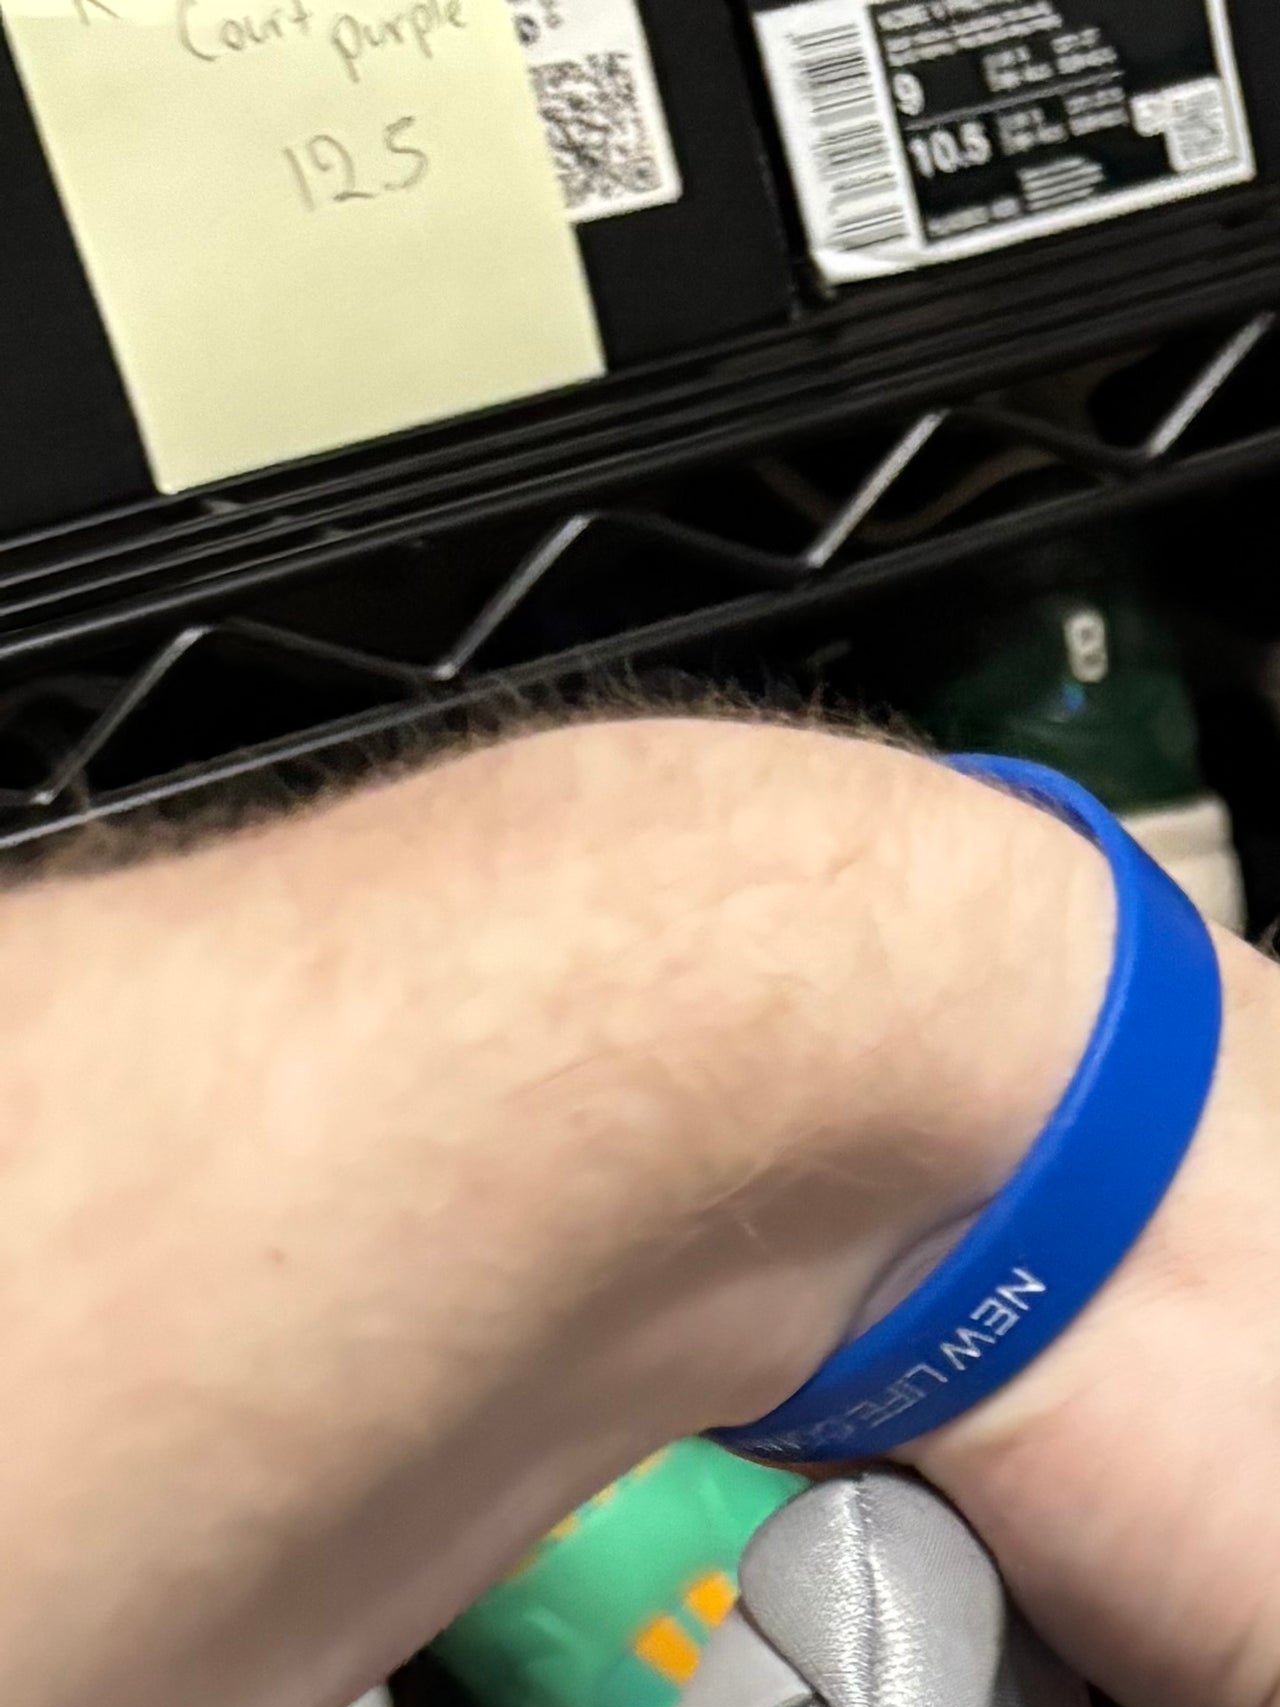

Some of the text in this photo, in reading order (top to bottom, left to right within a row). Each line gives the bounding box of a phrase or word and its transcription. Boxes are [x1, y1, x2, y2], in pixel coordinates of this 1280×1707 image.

[893, 72, 925, 117] 9
[909, 122, 992, 178] 10.5
[941, 1267, 1047, 1371] NEW
